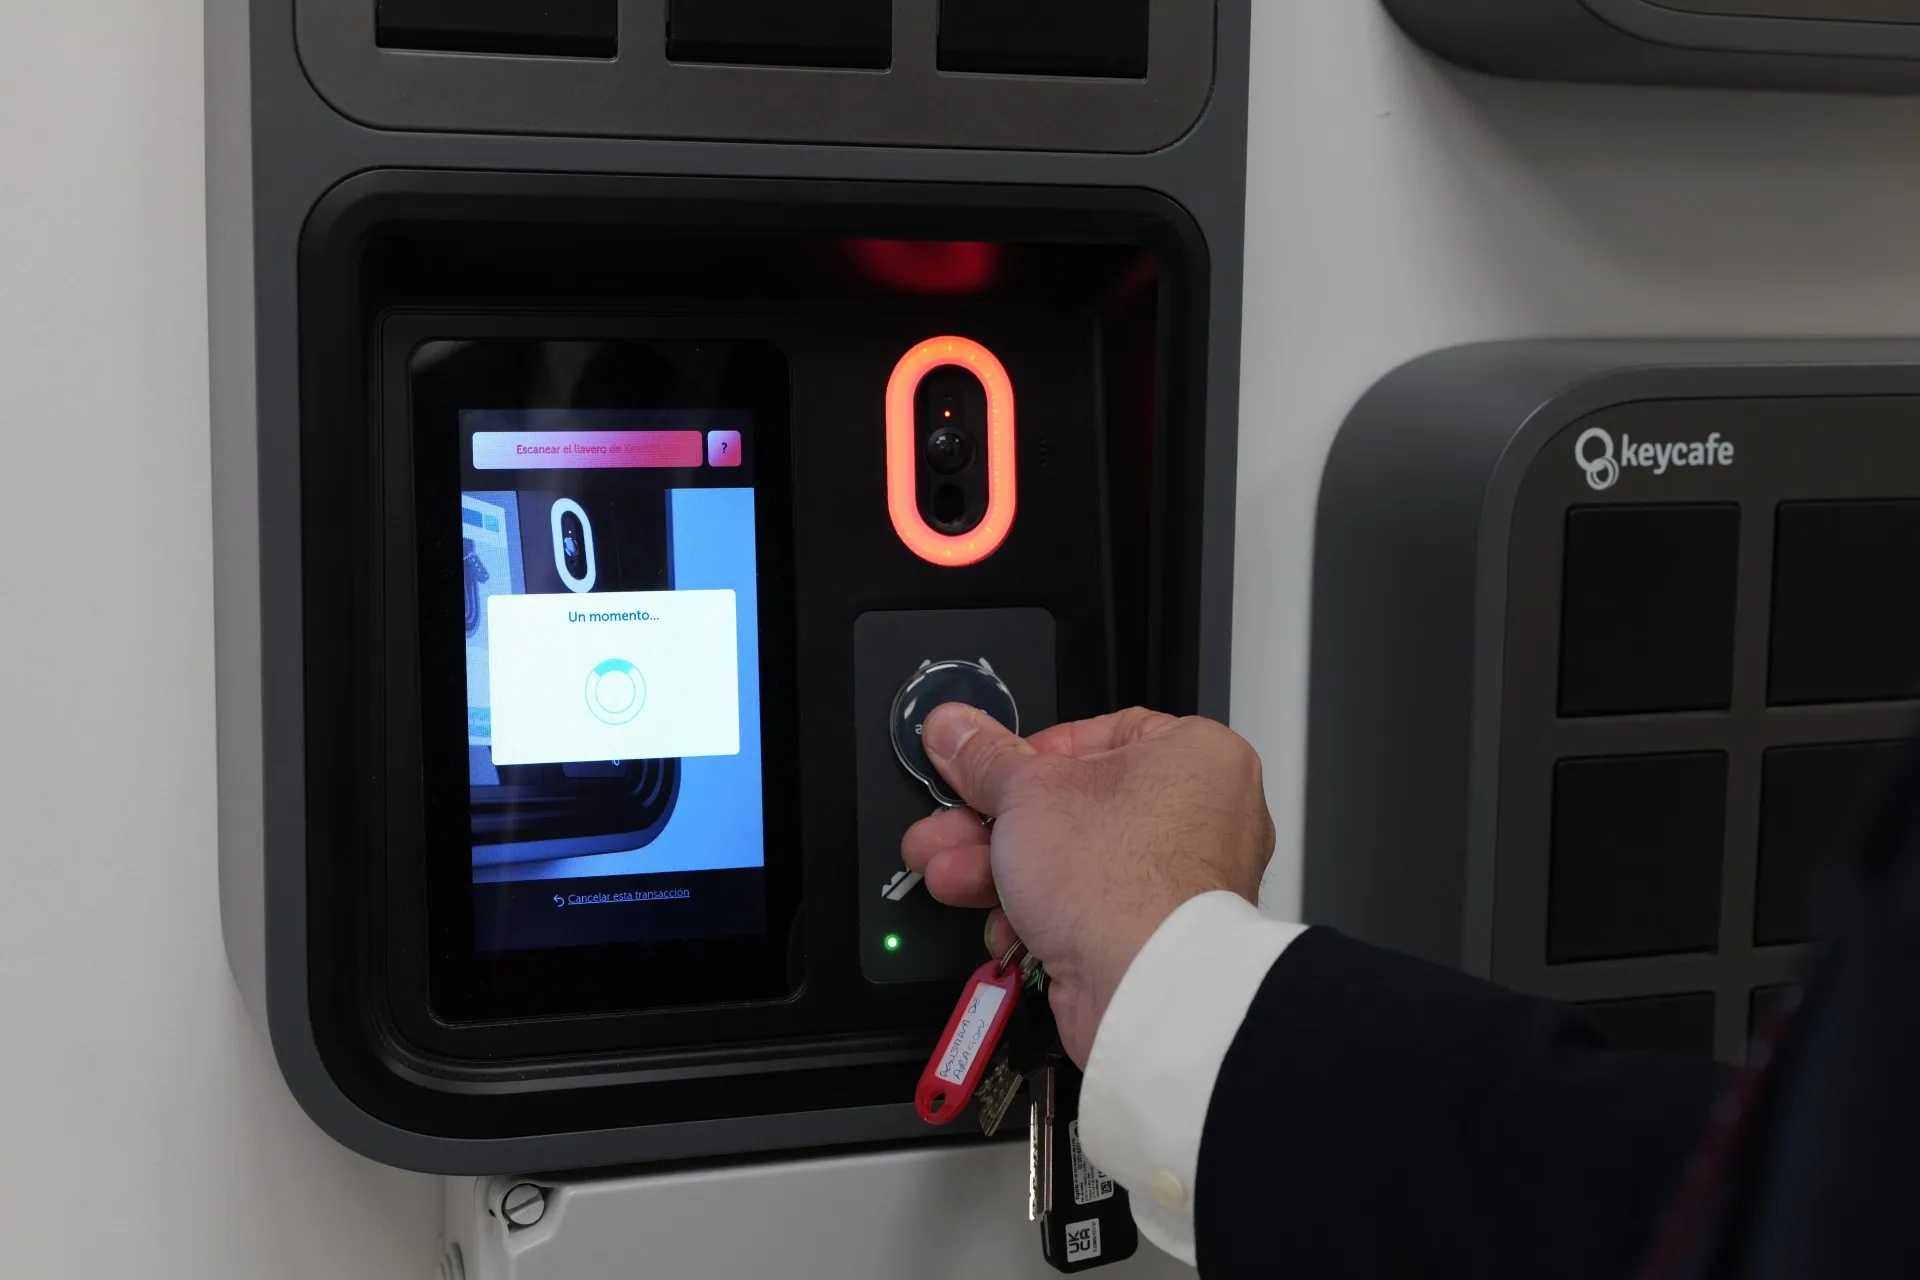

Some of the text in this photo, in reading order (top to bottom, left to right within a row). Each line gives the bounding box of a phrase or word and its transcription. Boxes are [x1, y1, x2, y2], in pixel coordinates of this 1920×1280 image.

[516, 444, 560, 455] Escanear
[563, 444, 572, 454] el
[574, 444, 607, 454] llavero
[721, 442, 728, 454] ?
[1621, 432, 1735, 475] keycafe
[568, 610, 660, 622] Un momento...
[568, 887, 690, 905] Cancelar esta transacción
[1068, 1230, 1079, 1254] UK
[1080, 1228, 1090, 1251] CA
